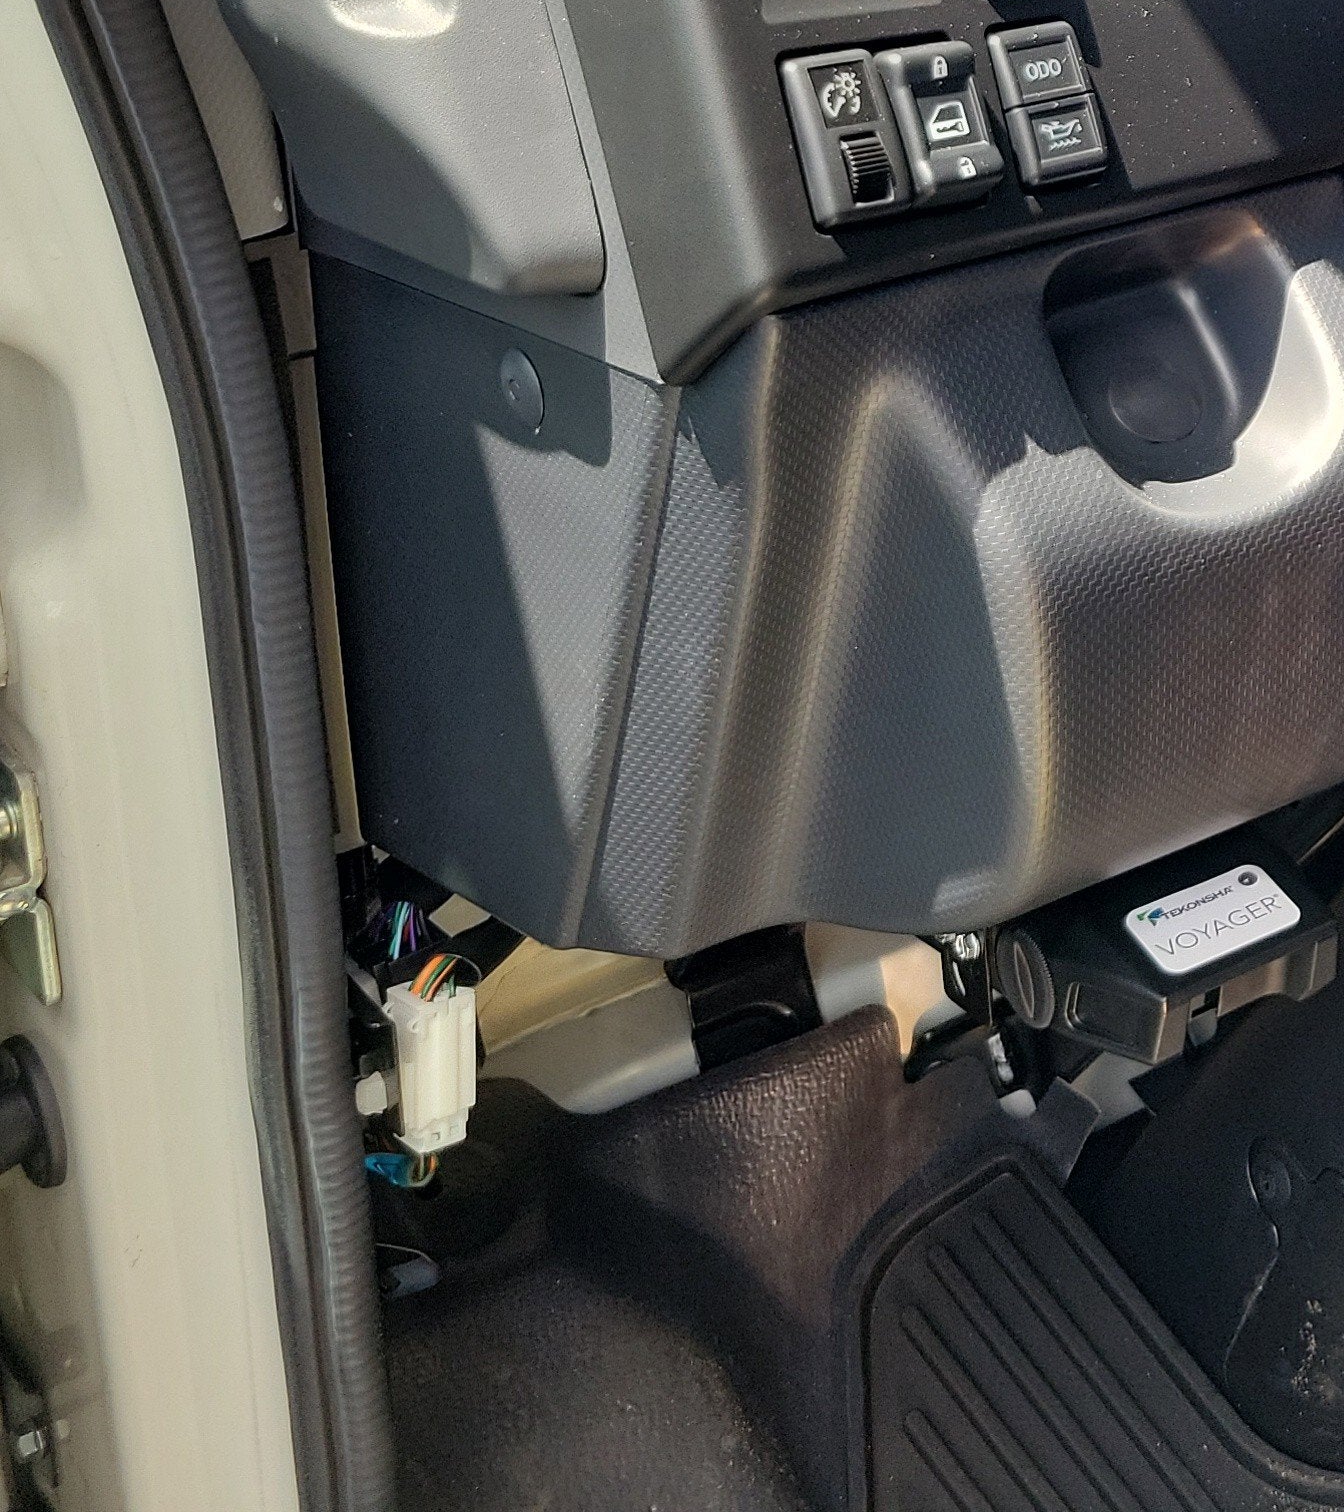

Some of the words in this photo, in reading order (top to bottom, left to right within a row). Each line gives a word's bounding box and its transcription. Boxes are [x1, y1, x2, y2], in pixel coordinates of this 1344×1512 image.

[1025, 58, 1062, 80] ODO
[1162, 885, 1234, 920] TEKONSHA
[1155, 896, 1282, 956] VOYAGER
